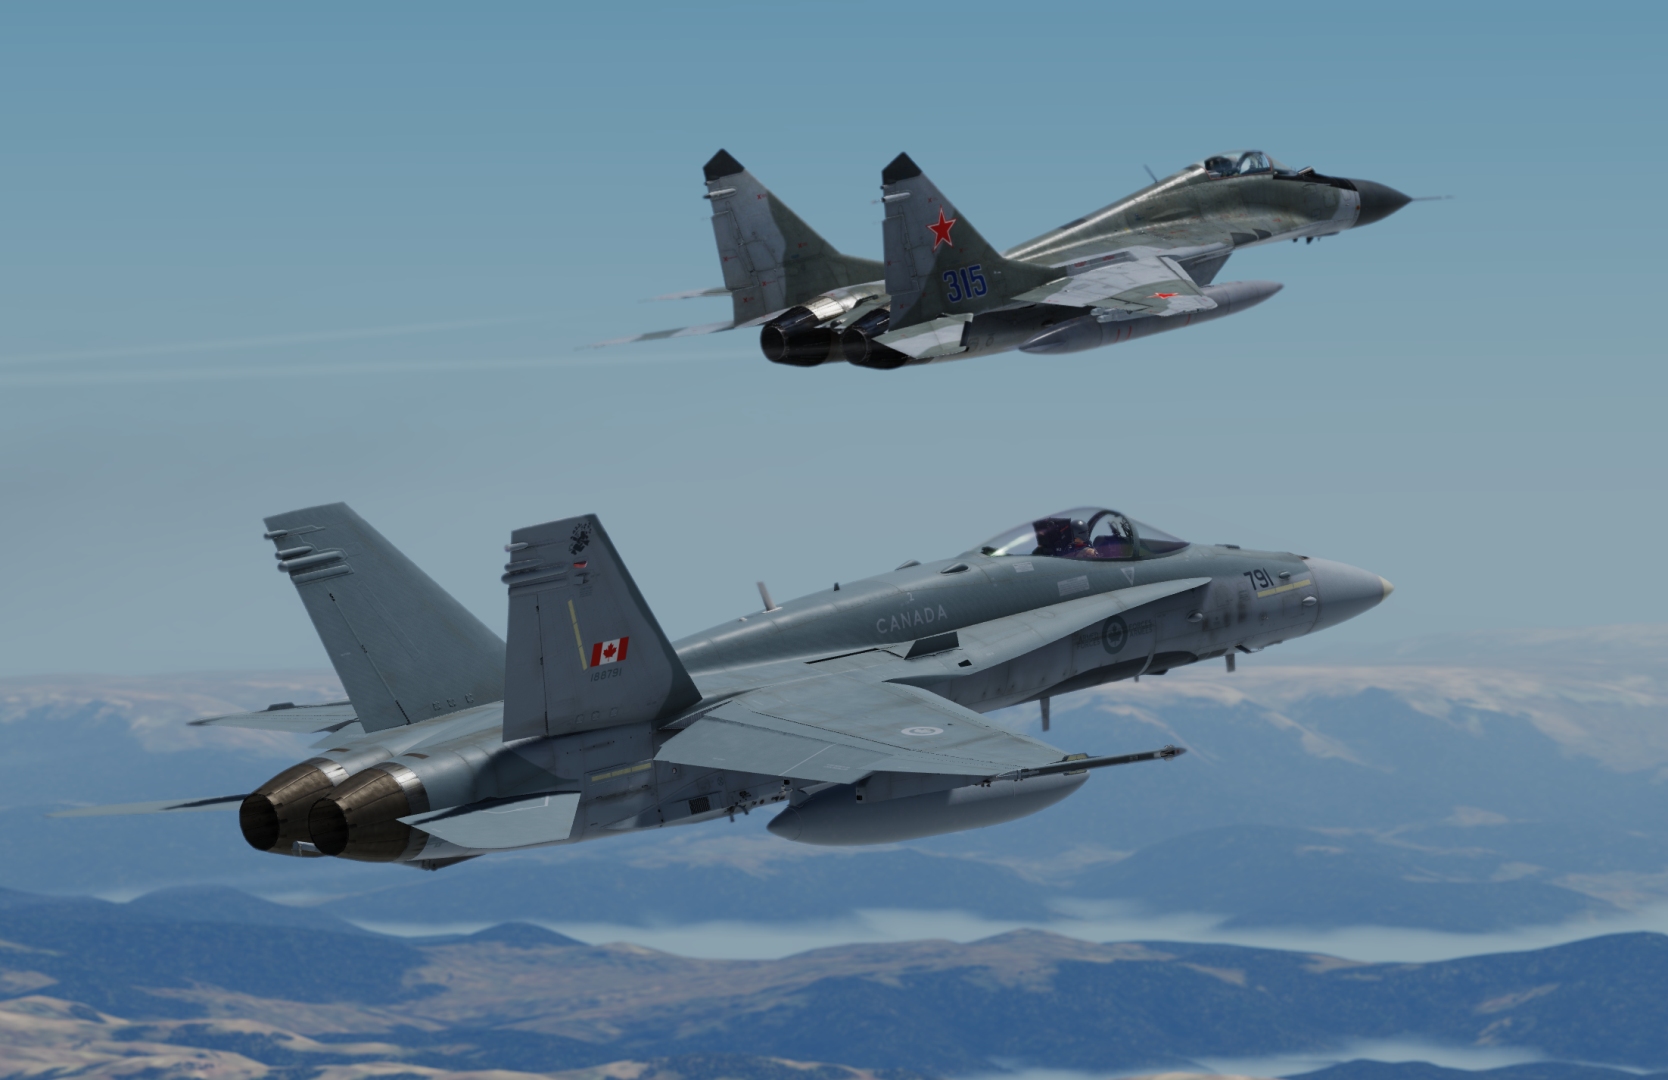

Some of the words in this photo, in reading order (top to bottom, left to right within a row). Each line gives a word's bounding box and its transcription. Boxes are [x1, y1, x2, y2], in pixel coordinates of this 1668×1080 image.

[943, 264, 988, 303] 315
[1243, 567, 1274, 591] 791
[876, 604, 948, 634] CANADA
[590, 667, 622, 682] 188791
